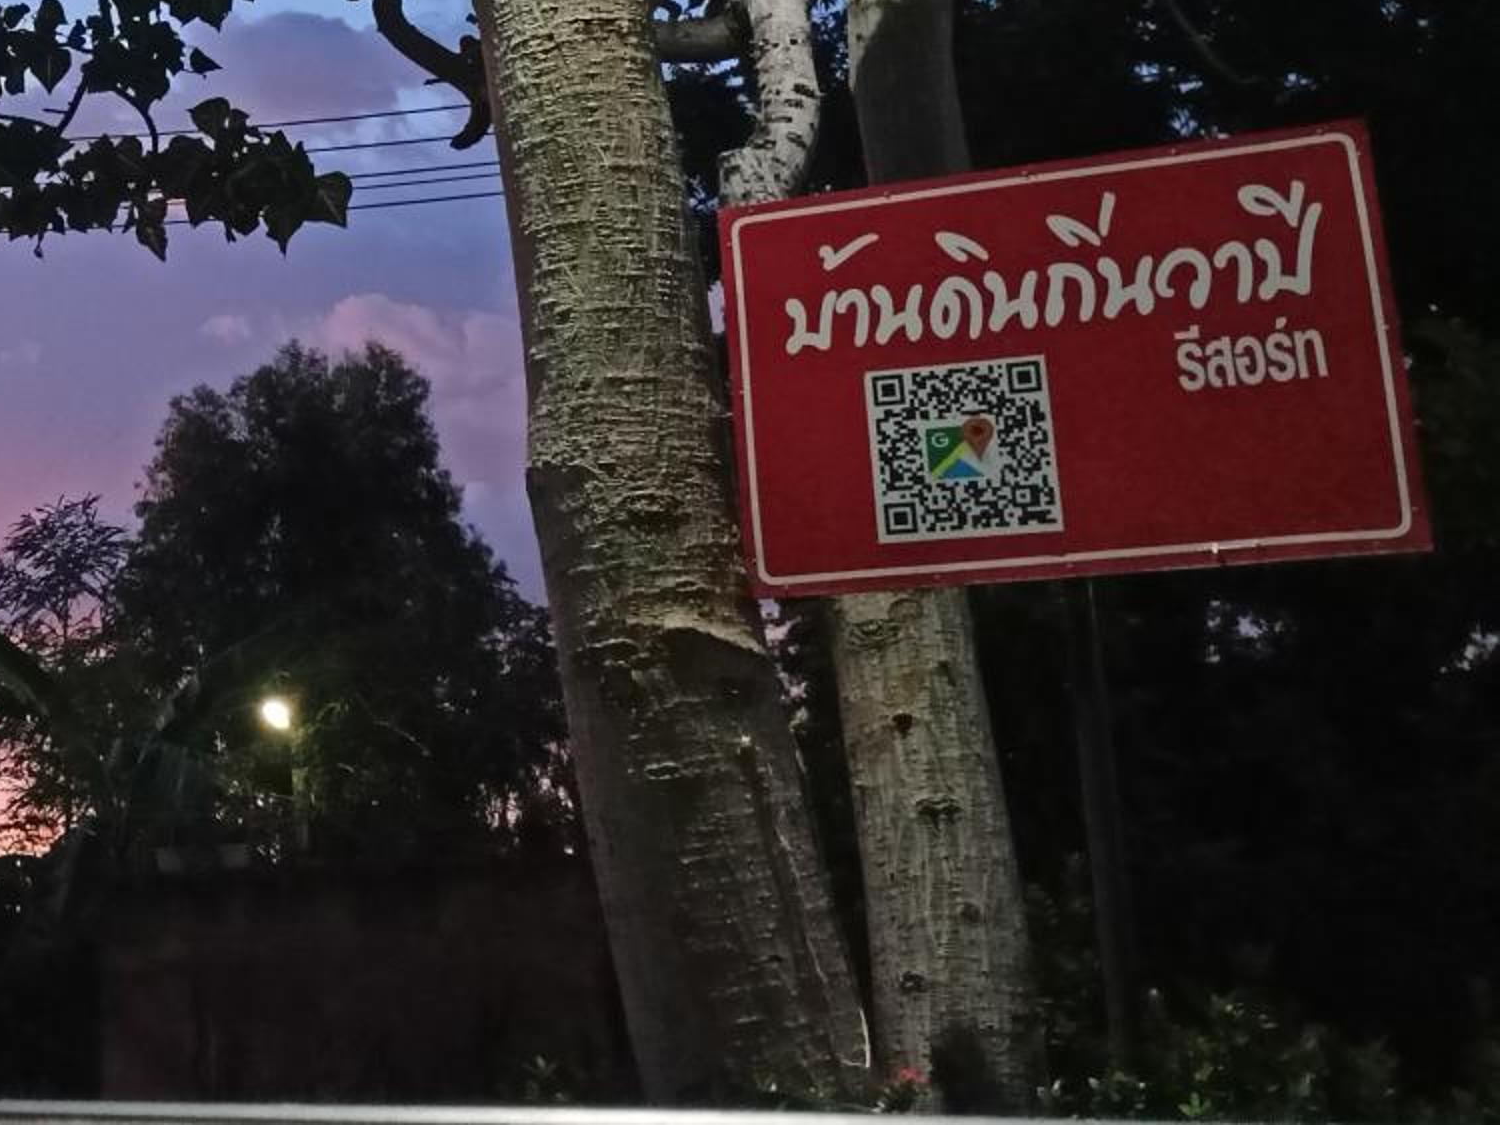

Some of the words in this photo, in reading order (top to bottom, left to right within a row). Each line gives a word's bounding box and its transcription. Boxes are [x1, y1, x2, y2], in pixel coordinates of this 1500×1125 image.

[1173, 316, 1329, 392] รีสอร์ท
[931, 431, 949, 448] G
